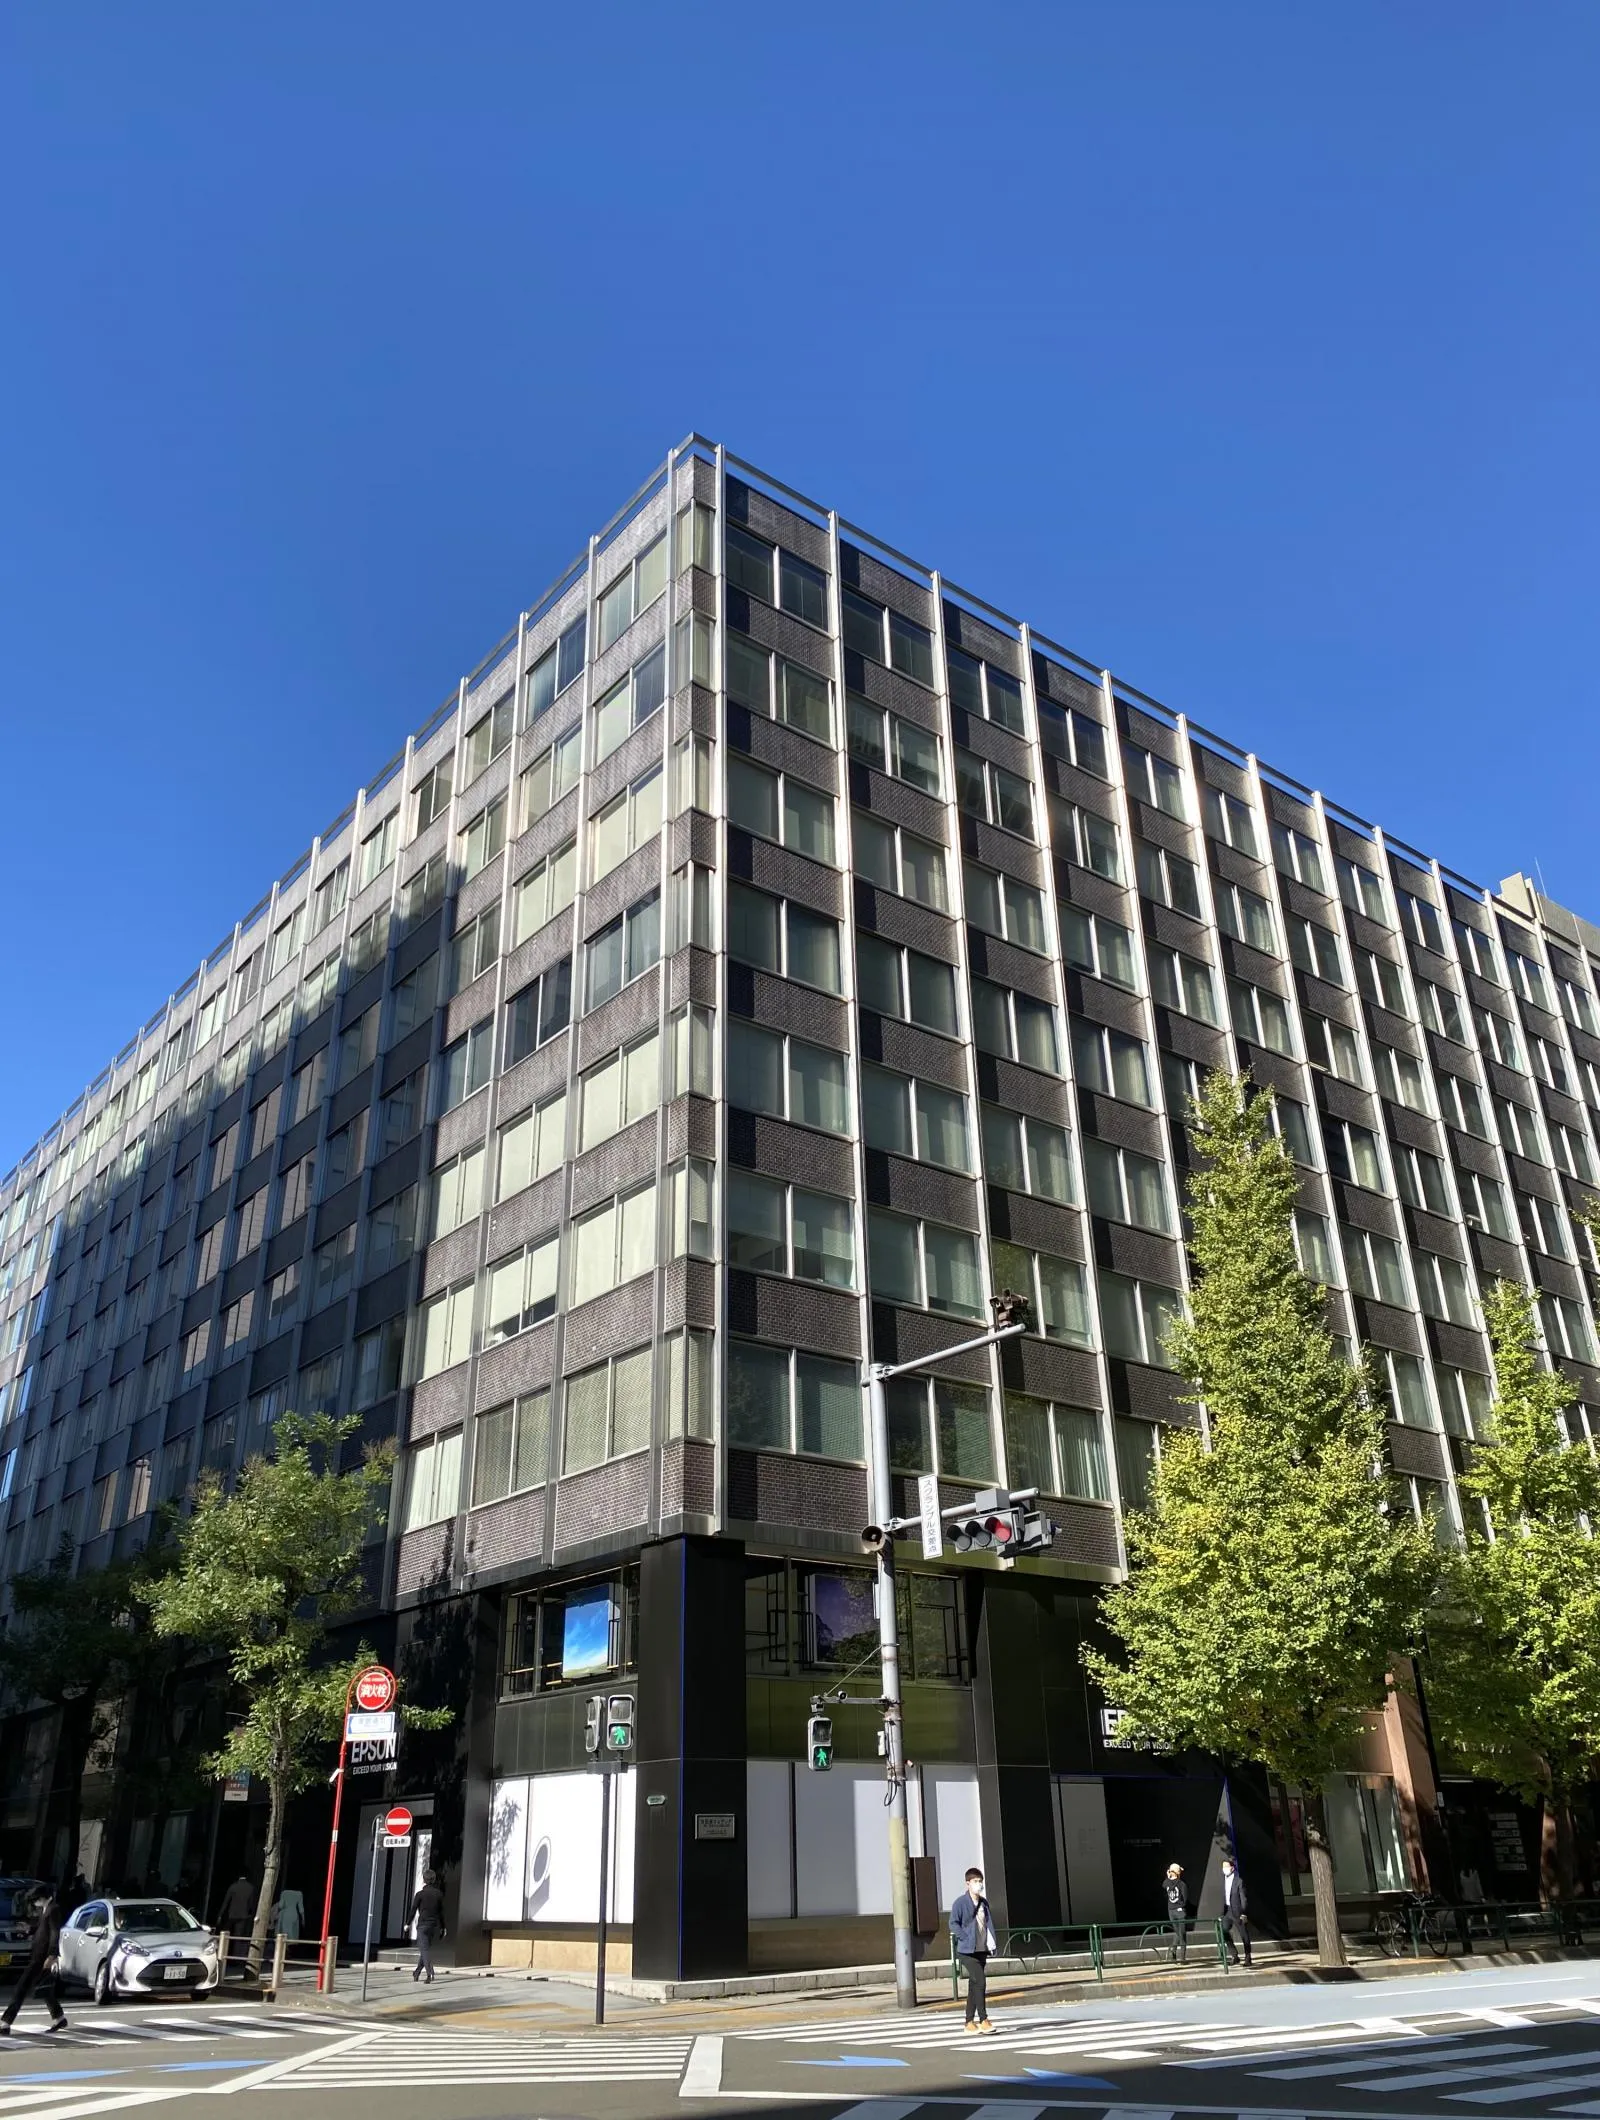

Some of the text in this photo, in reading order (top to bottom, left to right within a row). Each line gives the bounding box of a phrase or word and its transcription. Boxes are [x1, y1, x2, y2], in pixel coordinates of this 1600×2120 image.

[924, 1479, 937, 1553] スクランブル交差点
[360, 1684, 387, 1698] 消火栓
[351, 1731, 397, 1763] EPSON
